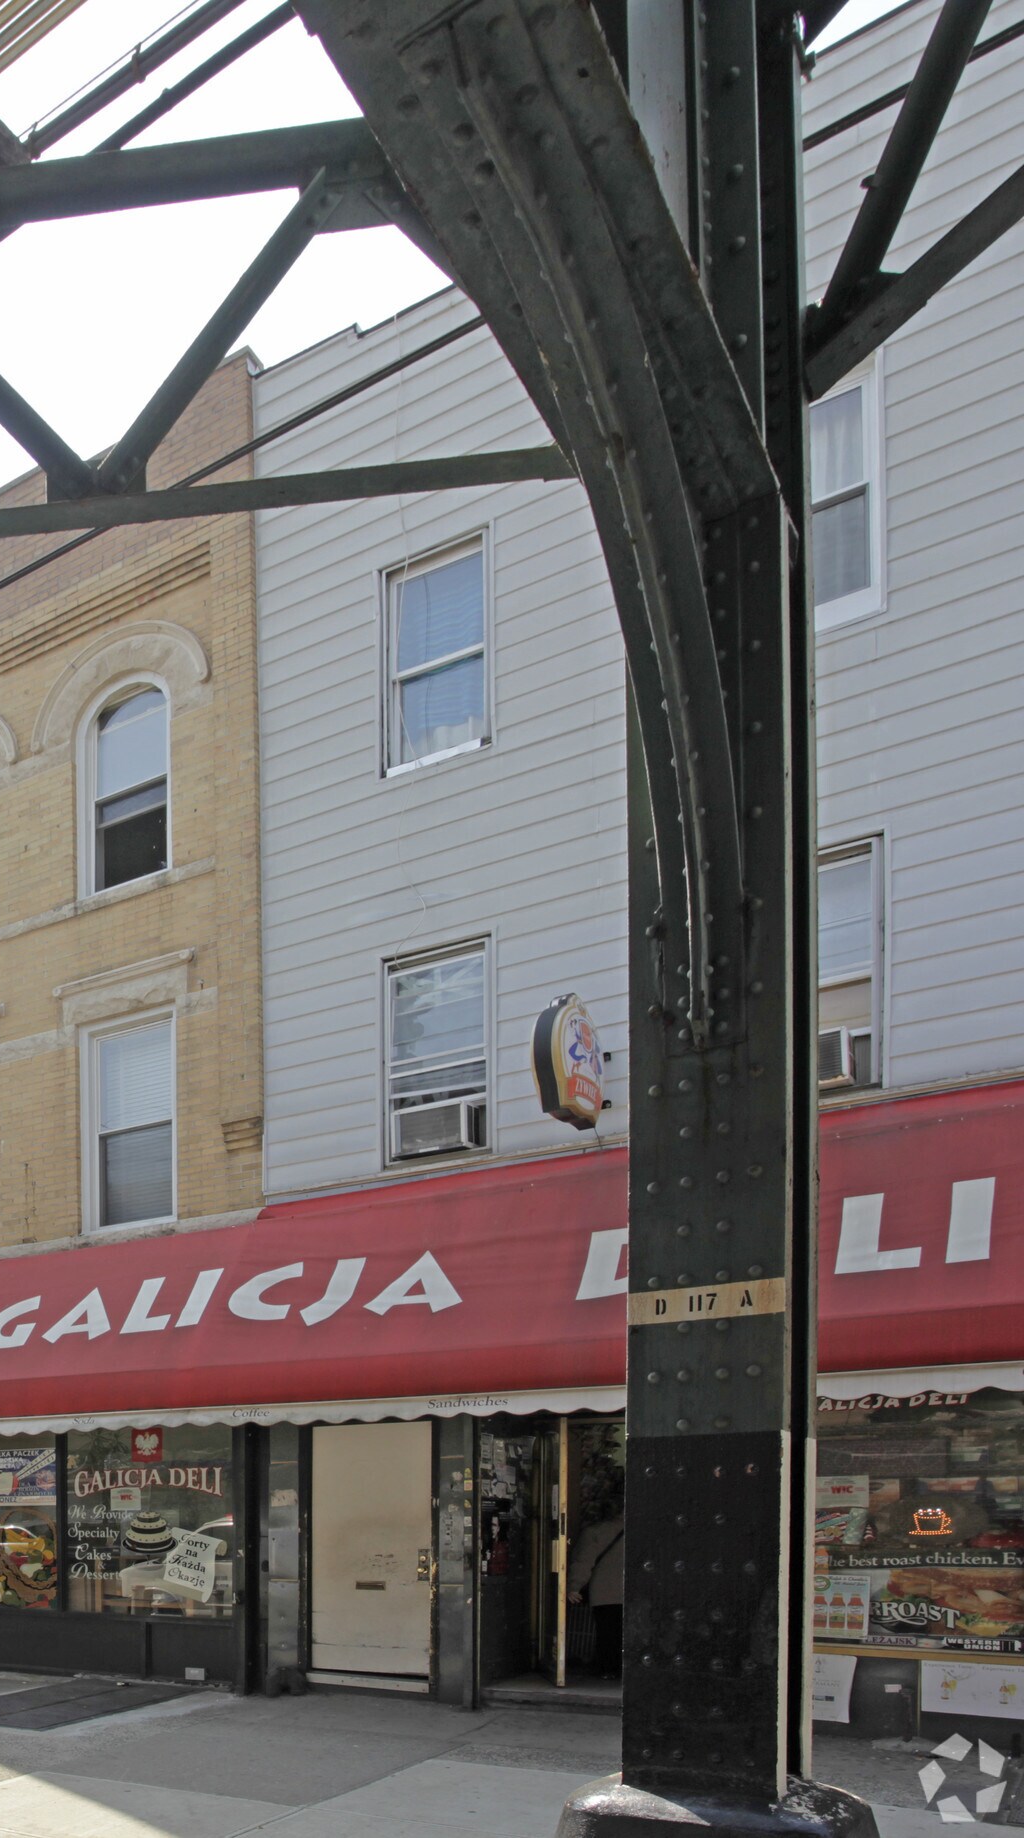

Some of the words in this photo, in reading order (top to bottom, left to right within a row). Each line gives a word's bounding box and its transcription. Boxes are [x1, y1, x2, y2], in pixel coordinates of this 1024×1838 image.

[655, 1298, 667, 1316] D
[689, 1293, 718, 1313] 117
[740, 1289, 753, 1308] A
[72, 1417, 95, 1425] Soda
[232, 1408, 271, 1419] Coffee
[427, 1396, 509, 1410] Sandwiches
[818, 1394, 900, 1412] ALICJA
[908, 1392, 969, 1408] DELI
[73, 1467, 162, 1498] GALICJA
[168, 1466, 223, 1497] DELI
[831, 1485, 854, 1495] WIC
[68, 1504, 87, 1520] We
[90, 1503, 134, 1520] Provide
[67, 1521, 120, 1541] Specialty
[178, 1533, 210, 1551] Torty
[75, 1542, 112, 1561] Cakes
[185, 1548, 198, 1558] na
[829, 1554, 845, 1567] he
[849, 1554, 878, 1567] best
[883, 1553, 921, 1566] roast
[926, 1552, 998, 1566] chicken.
[947, 1638, 1001, 1646] WESTERN
